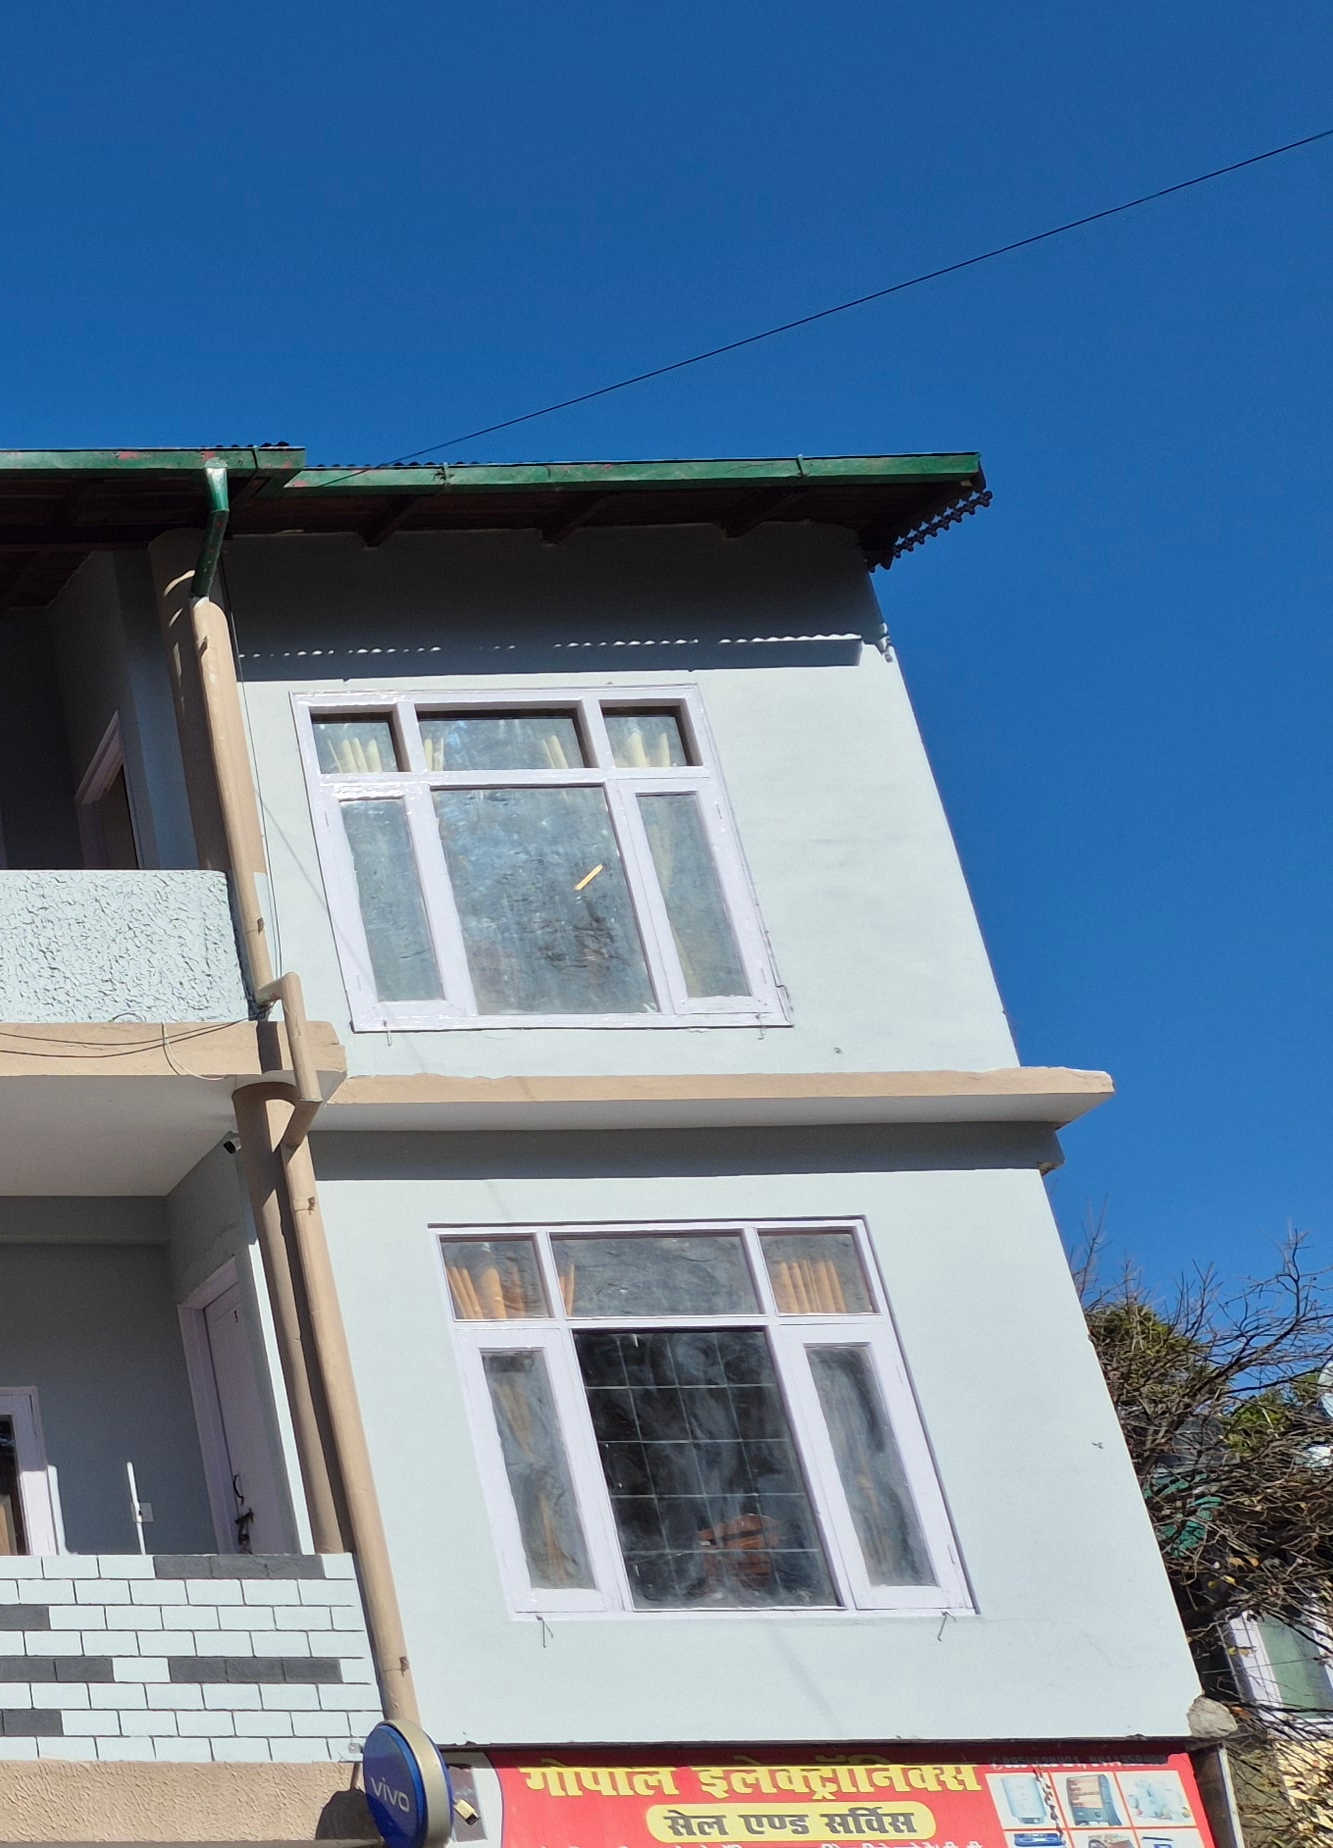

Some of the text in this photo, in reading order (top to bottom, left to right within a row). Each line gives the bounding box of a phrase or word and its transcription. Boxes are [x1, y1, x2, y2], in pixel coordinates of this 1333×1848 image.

[370, 1776, 411, 1813] vivo
[517, 1757, 681, 1797] गोपाल
[663, 1806, 918, 1837] सेल एण्ड सर्विस
